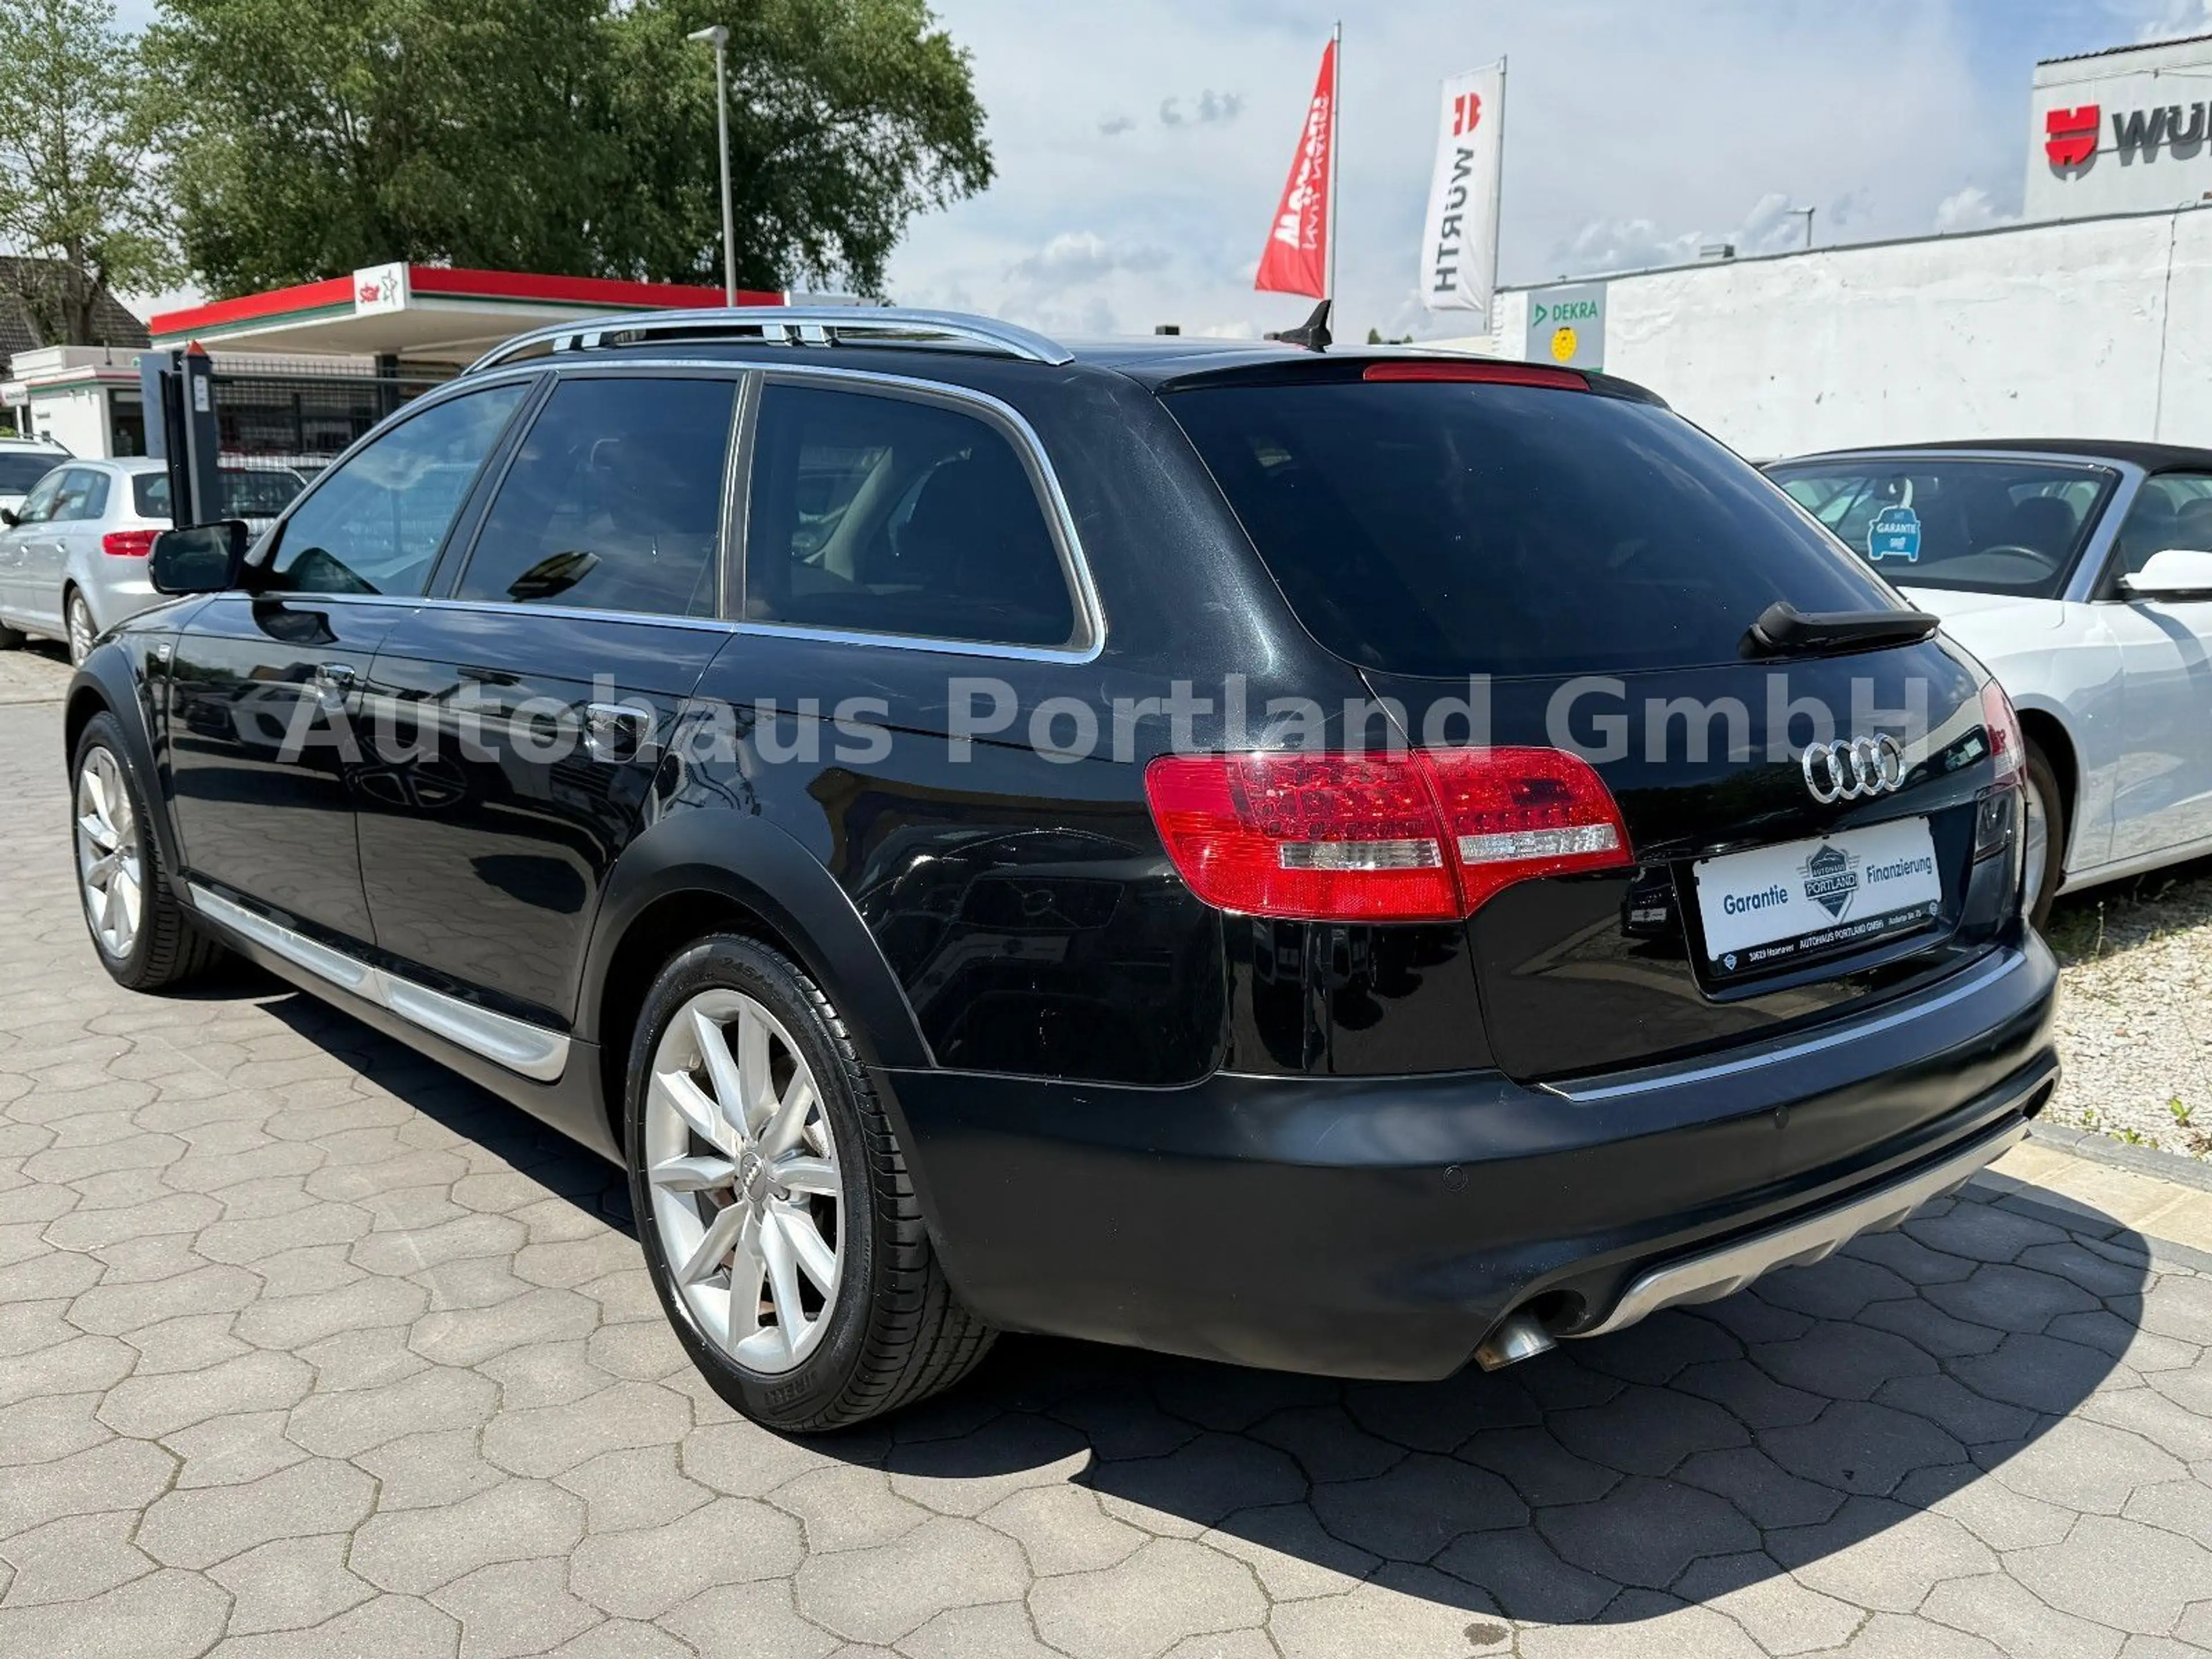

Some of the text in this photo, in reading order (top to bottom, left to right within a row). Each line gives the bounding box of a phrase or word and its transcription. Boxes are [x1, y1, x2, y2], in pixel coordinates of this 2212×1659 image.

[1552, 300, 1598, 321] DEKRA
[1866, 857, 1932, 884] Finanzierung
[1806, 874, 1855, 895] PORTLAND
[1724, 884, 1789, 915] Garantie
[1799, 931, 1834, 949] AUTOHAUS
[1835, 924, 1866, 940] PORTLAND
